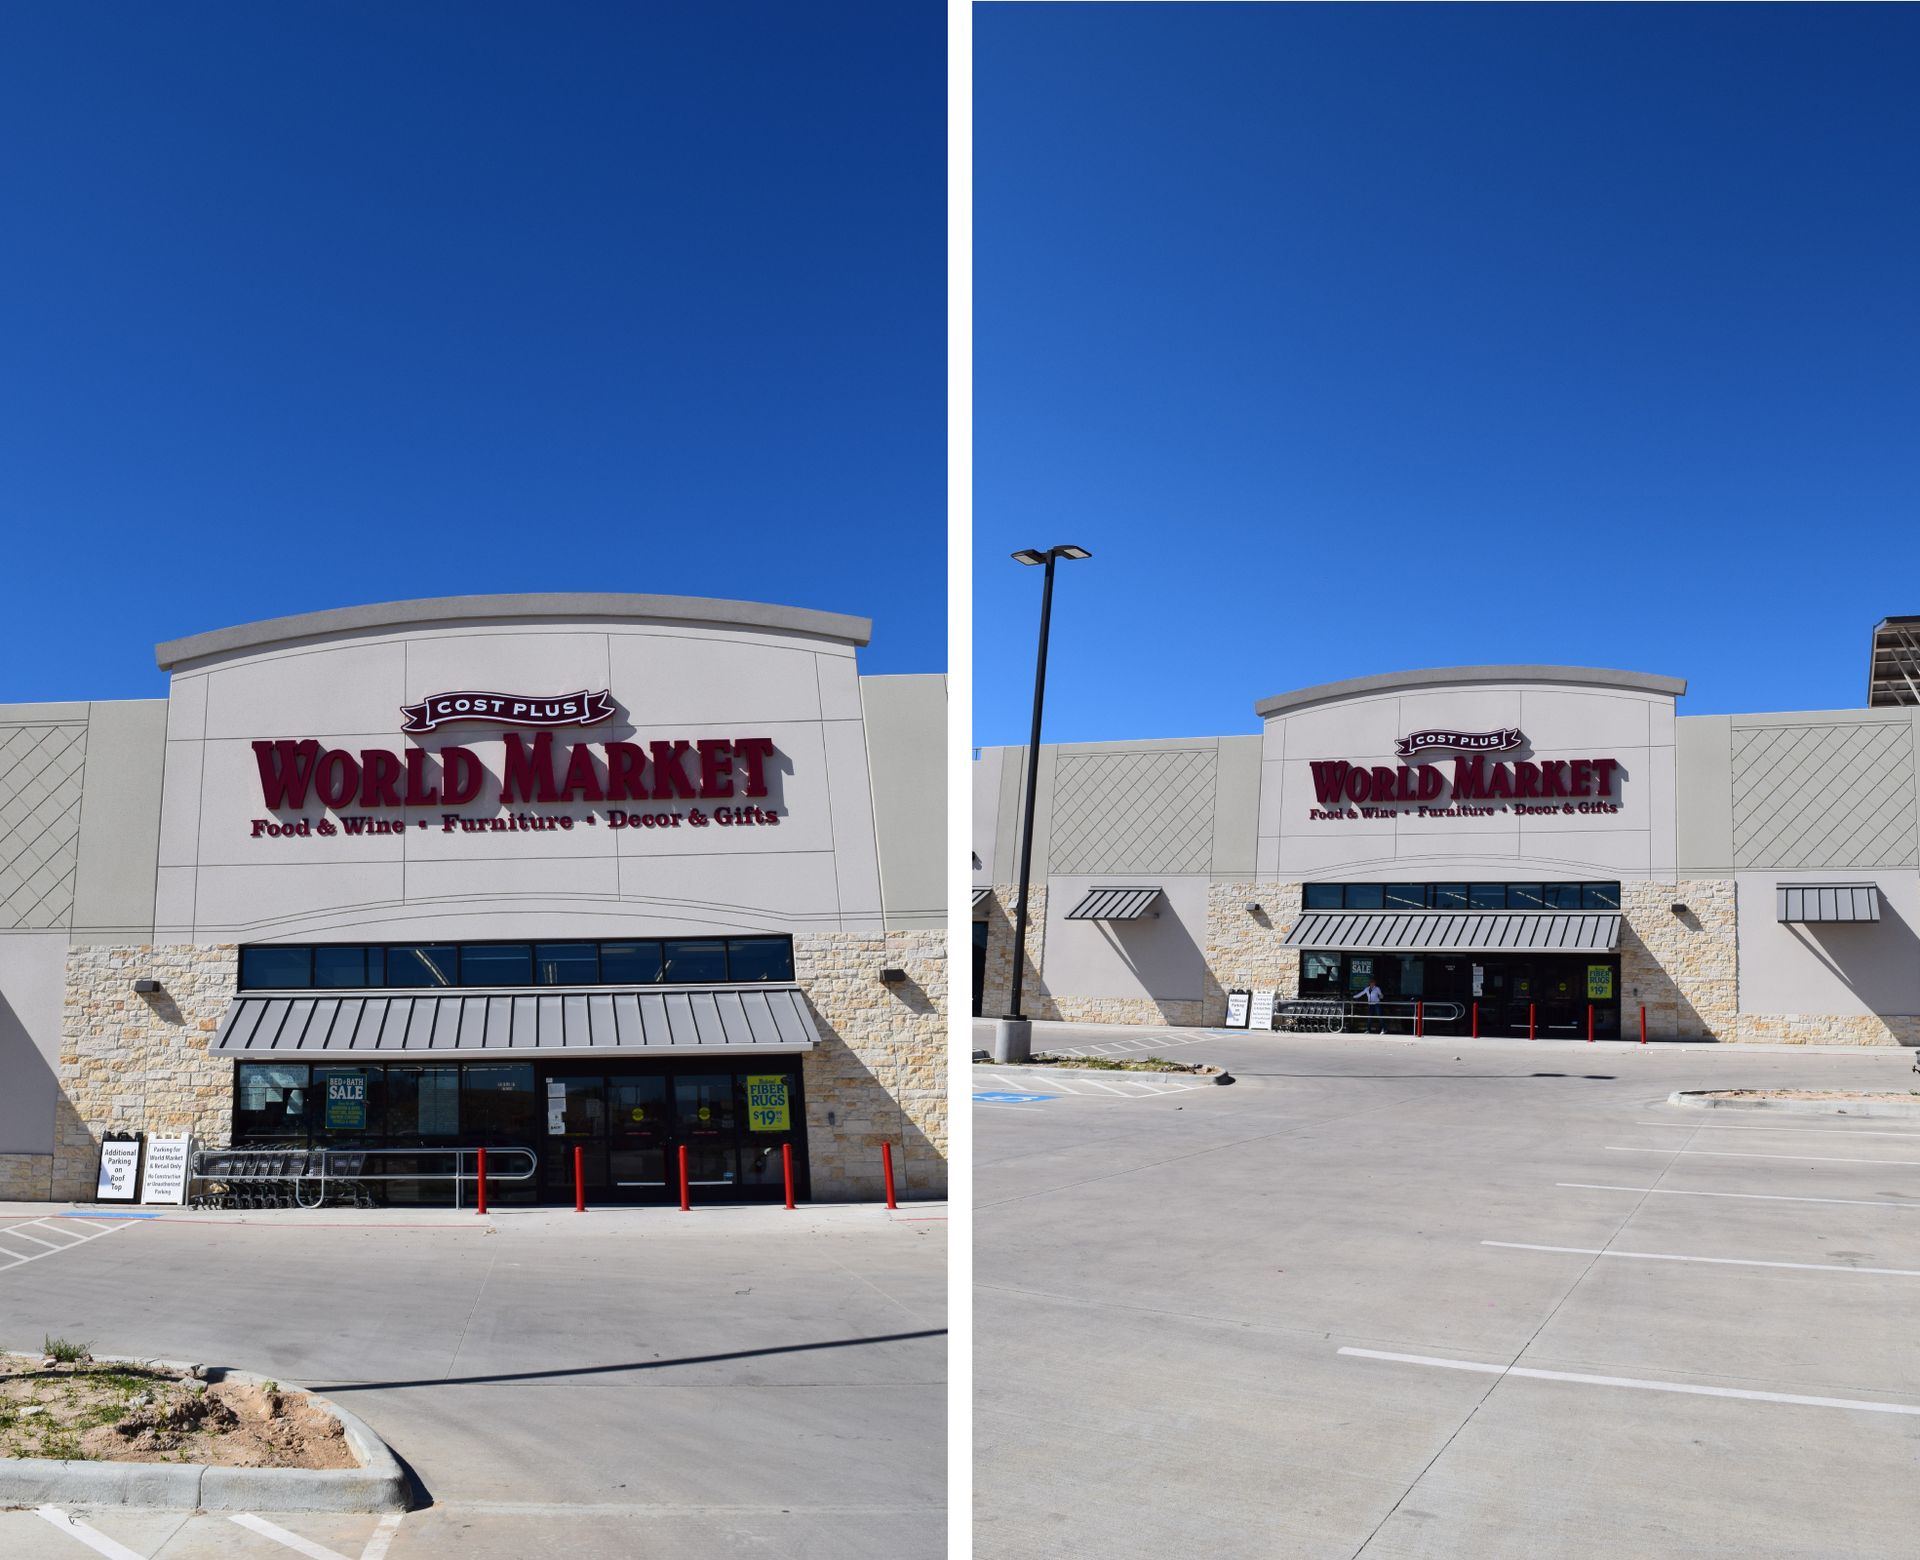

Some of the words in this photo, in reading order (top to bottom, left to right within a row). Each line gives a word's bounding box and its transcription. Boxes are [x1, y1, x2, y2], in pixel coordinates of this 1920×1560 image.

[436, 699, 505, 715] COST
[513, 699, 578, 717] PLUS
[1415, 734, 1456, 746] COST
[1461, 735, 1500, 747] PLUS
[251, 738, 484, 810] WORLD
[500, 731, 774, 805] MARKET
[1309, 760, 1444, 804] WORLD
[1450, 755, 1617, 800] MARKET
[1310, 808, 1344, 820] Food
[1347, 808, 1358, 819] &
[1361, 806, 1397, 818] Wine
[1417, 805, 1495, 818] Furniture
[1514, 803, 1560, 816] Decor
[1562, 802, 1574, 814] &
[1578, 801, 1618, 814] Gifts
[250, 818, 311, 837] Food
[316, 818, 337, 835] &
[340, 816, 405, 835] Wine
[441, 813, 572, 833] Furniture
[607, 809, 682, 828] Decor
[687, 807, 708, 826] &
[713, 806, 780, 826] Gifts
[329, 1086, 364, 1100] SALE
[751, 1084, 785, 1094] FIBER
[751, 1094, 785, 1106] RUGS
[154, 1146, 173, 1154] Parking
[107, 1158, 131, 1166] Parking
[110, 1174, 125, 1182] Roof
[111, 1183, 122, 1191] Top
